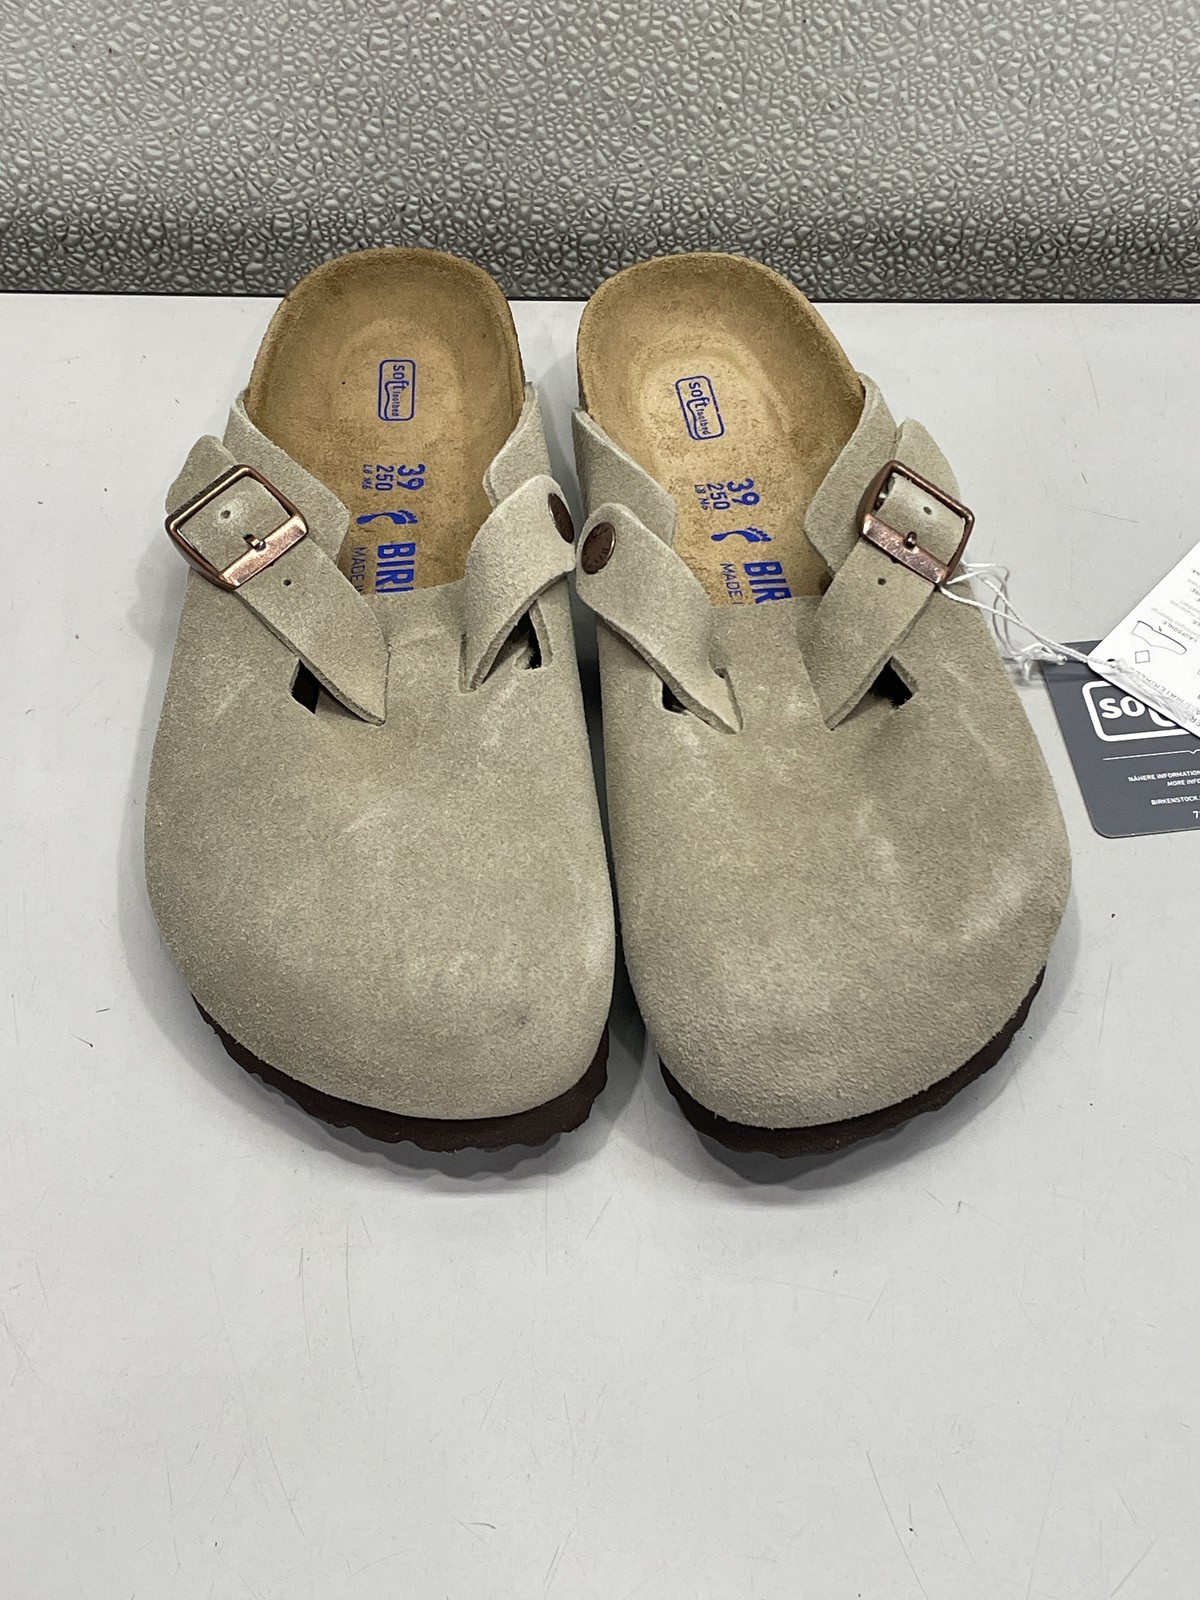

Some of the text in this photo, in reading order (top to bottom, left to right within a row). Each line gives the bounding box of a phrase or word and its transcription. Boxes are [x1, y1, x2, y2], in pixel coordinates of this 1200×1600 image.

[387, 364, 409, 391] soft
[689, 382, 710, 409] soft
[375, 464, 394, 491] 250
[396, 463, 426, 491] 39
[706, 482, 730, 510] 250
[726, 477, 760, 506] 39
[350, 546, 367, 582] MADE
[375, 542, 416, 593] BIR
[720, 563, 743, 598] MADE
